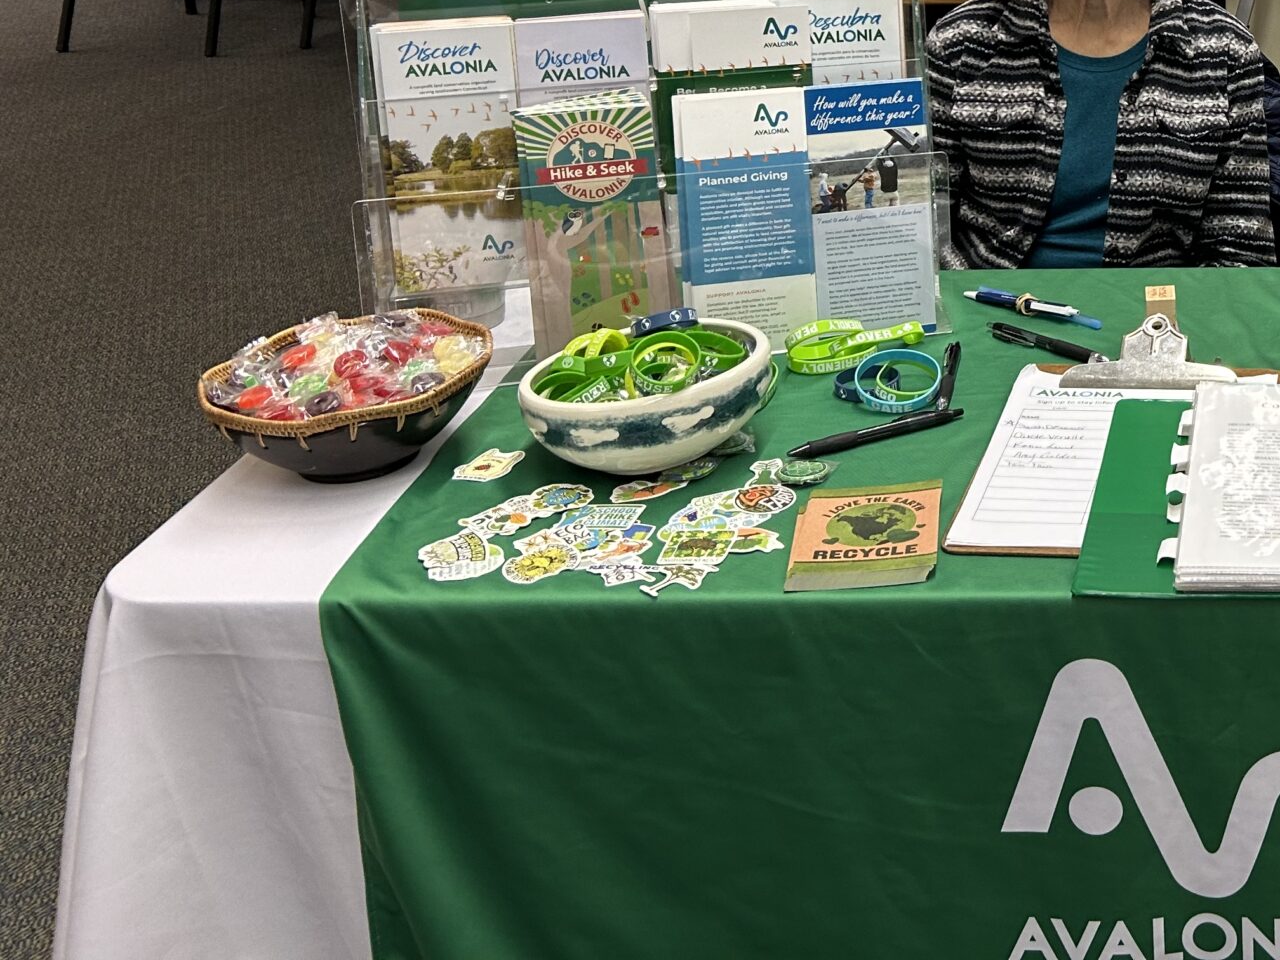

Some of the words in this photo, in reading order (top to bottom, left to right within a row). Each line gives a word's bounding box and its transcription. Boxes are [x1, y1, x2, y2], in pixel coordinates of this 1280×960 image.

[398, 40, 481, 65] Discover
[535, 47, 610, 70] Discover
[405, 58, 498, 79] AVALONIA
[540, 64, 630, 83] AVALONIA
[813, 95, 836, 111] How
[838, 93, 858, 108] will
[858, 98, 877, 112] you
[879, 91, 905, 104] make
[906, 93, 913, 102] a
[810, 111, 863, 131] difference
[865, 109, 884, 122] this
[885, 104, 921, 125] year?
[557, 123, 623, 146] DISCOVER
[754, 126, 789, 136] AVALONIA
[550, 167, 583, 180] Hike
[586, 165, 597, 177] &
[599, 162, 635, 176] Seek
[699, 173, 748, 187] Planned
[750, 171, 788, 182] Giving
[562, 177, 627, 199] AVALONIA
[483, 254, 515, 262] AVALONIA
[706, 291, 734, 299] SUPPORT
[735, 288, 767, 296] AVALONIA
[847, 329, 892, 346] LOVER
[1036, 389, 1124, 398] AVALONIA
[829, 499, 861, 515] LOVE
[865, 496, 891, 504] THE
[893, 496, 927, 512] EARTH
[555, 523, 583, 538] ECO
[563, 530, 592, 545] BAG
[812, 543, 919, 560] RECYCLE
